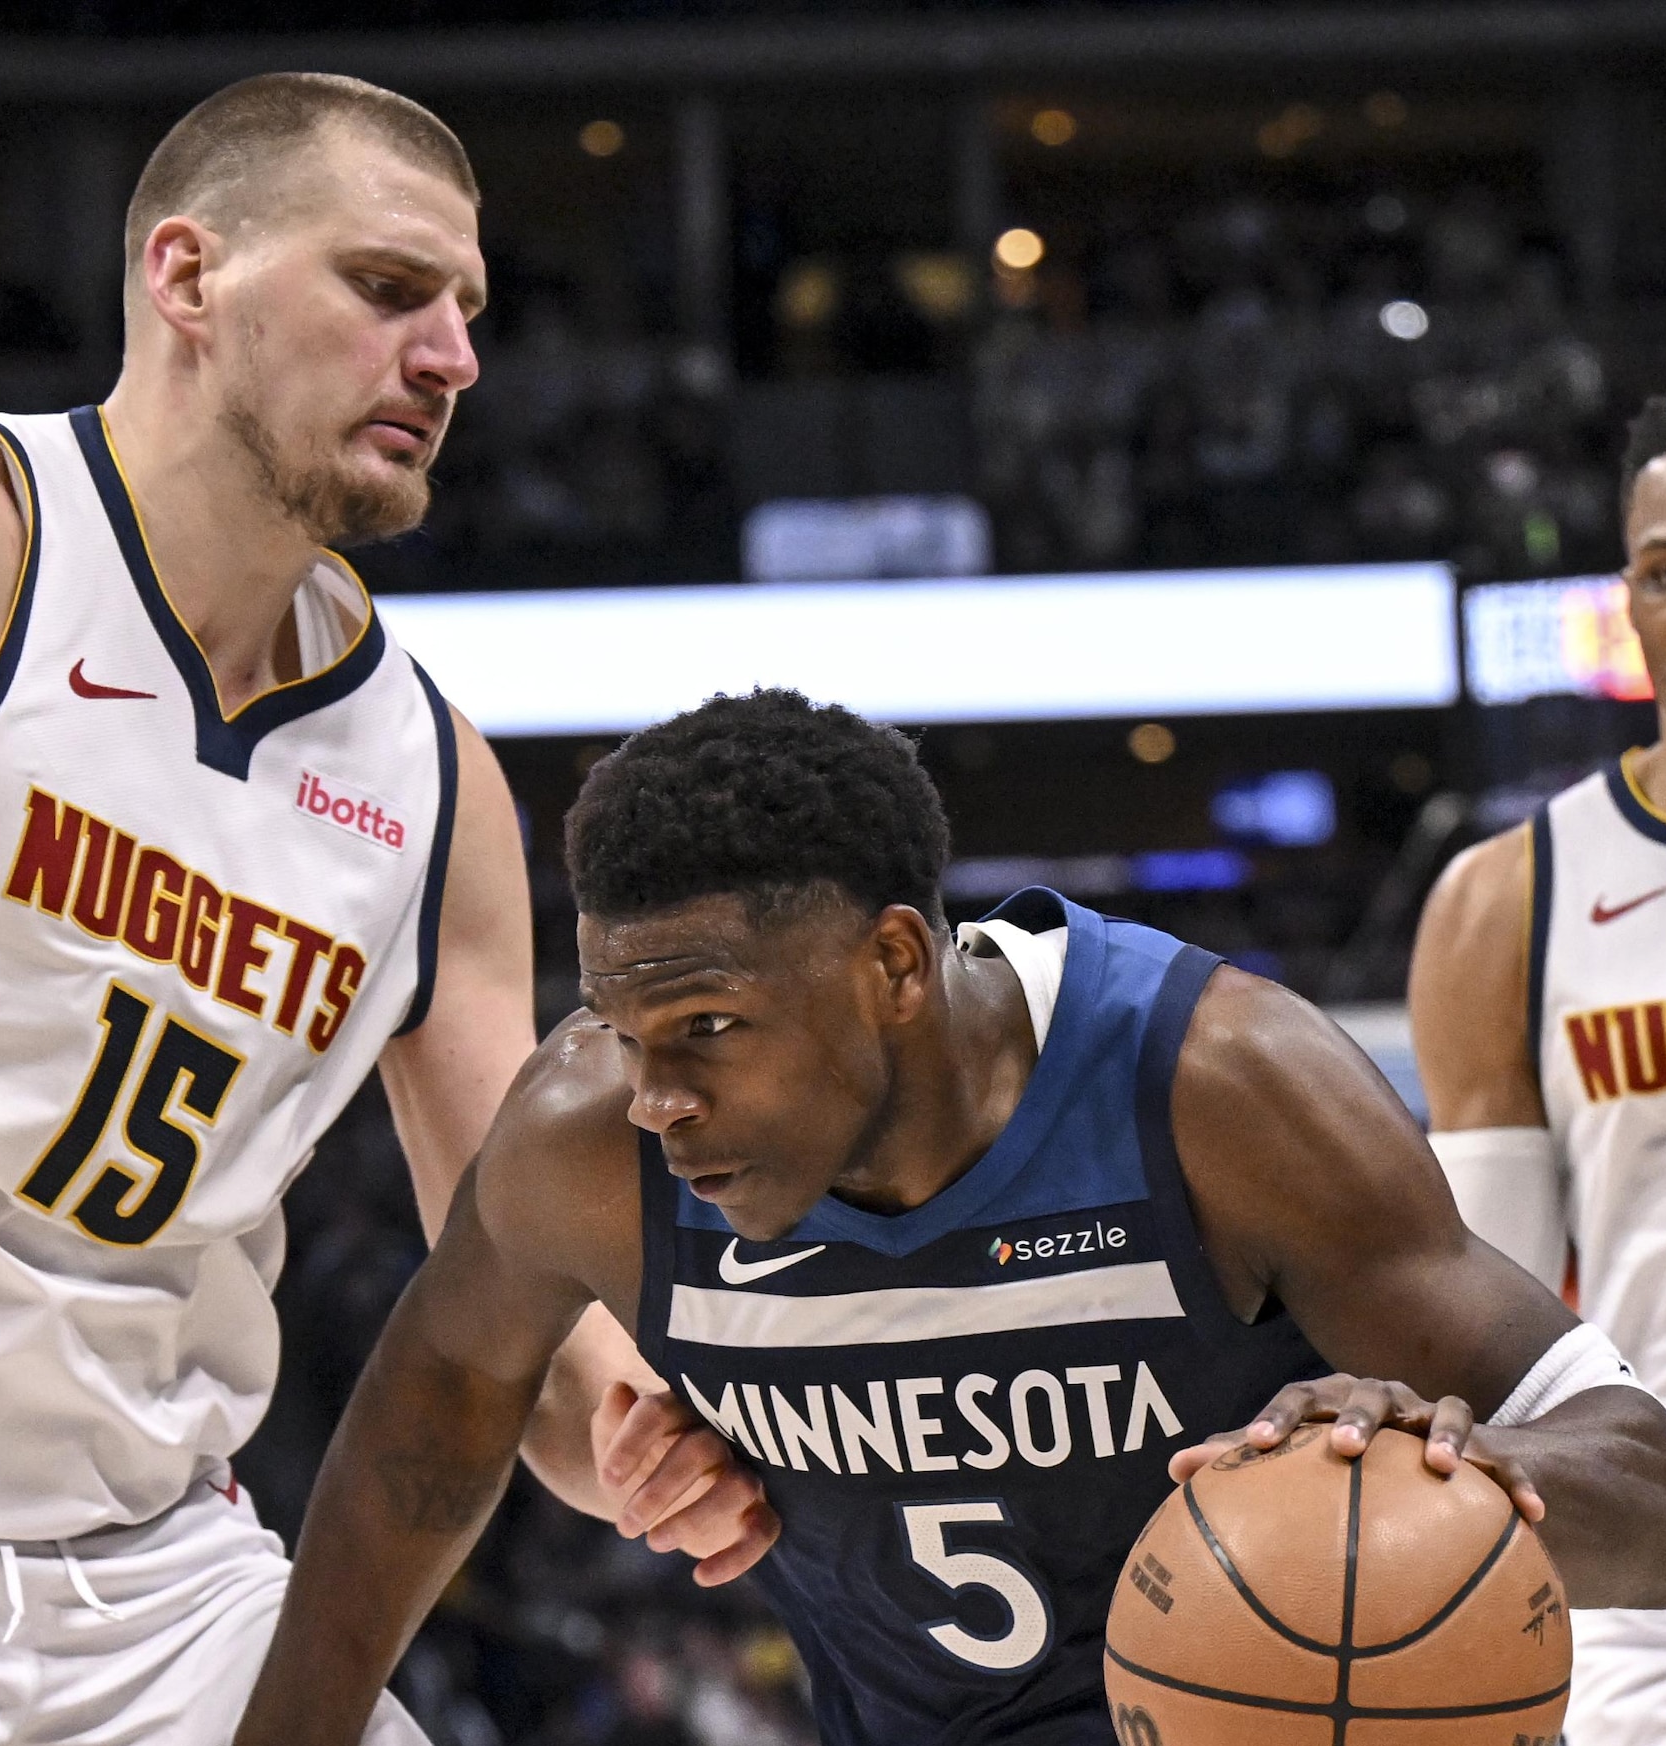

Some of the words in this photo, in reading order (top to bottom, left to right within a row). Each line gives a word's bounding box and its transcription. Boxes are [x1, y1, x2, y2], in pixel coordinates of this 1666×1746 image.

[296, 770, 405, 851] ibotta
[2, 782, 369, 1055] NUGGETS
[12, 978, 247, 1249] 15
[1014, 1221, 1128, 1263] sezzle
[680, 1360, 1185, 1475] MINNESOTA
[896, 1498, 1053, 1674] 5
